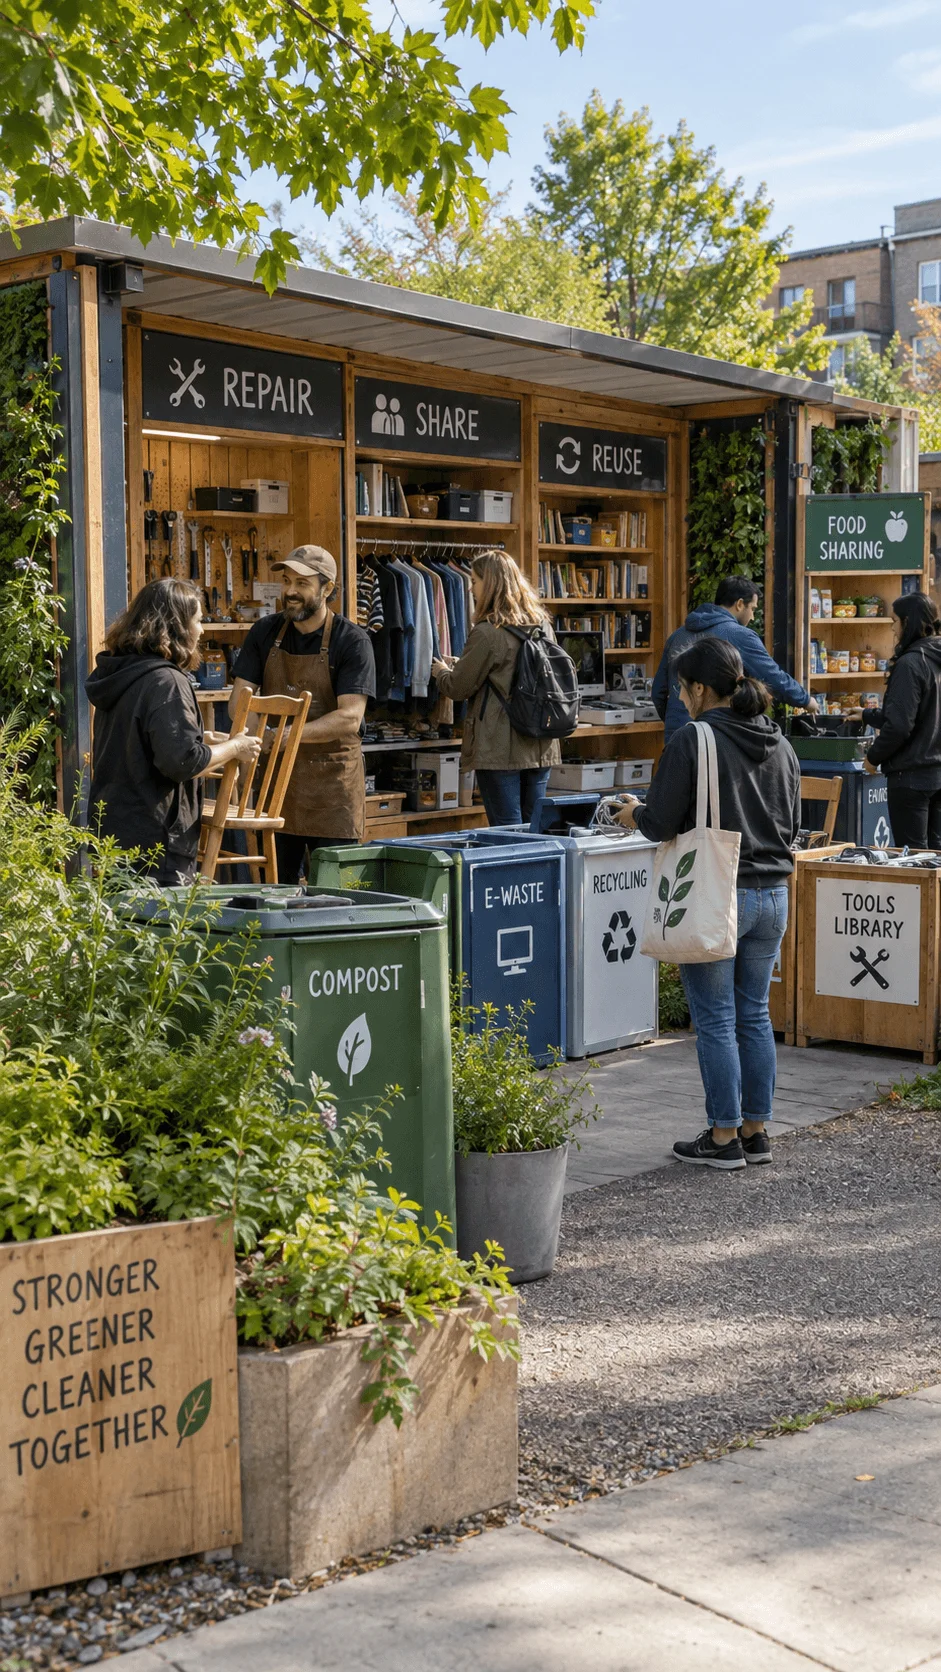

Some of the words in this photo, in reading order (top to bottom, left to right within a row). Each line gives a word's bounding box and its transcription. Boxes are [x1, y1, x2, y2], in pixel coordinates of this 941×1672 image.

[223, 367, 314, 417] REPAIR
[415, 402, 480, 441] SHARE
[592, 443, 643, 476] REUSE
[828, 515, 867, 535] FOOD
[819, 540, 885, 561] SHARING
[484, 881, 544, 909] E-WASTE
[593, 868, 648, 895] RECYCLING
[841, 892, 895, 915] TOOLS
[834, 916, 904, 940] LIBRARY
[308, 963, 403, 998] COMPOST
[12, 1258, 159, 1315] STRONGER
[25, 1308, 155, 1364] GREENER
[22, 1357, 155, 1418] CLEANER
[9, 1405, 168, 1476] TOGETHER
